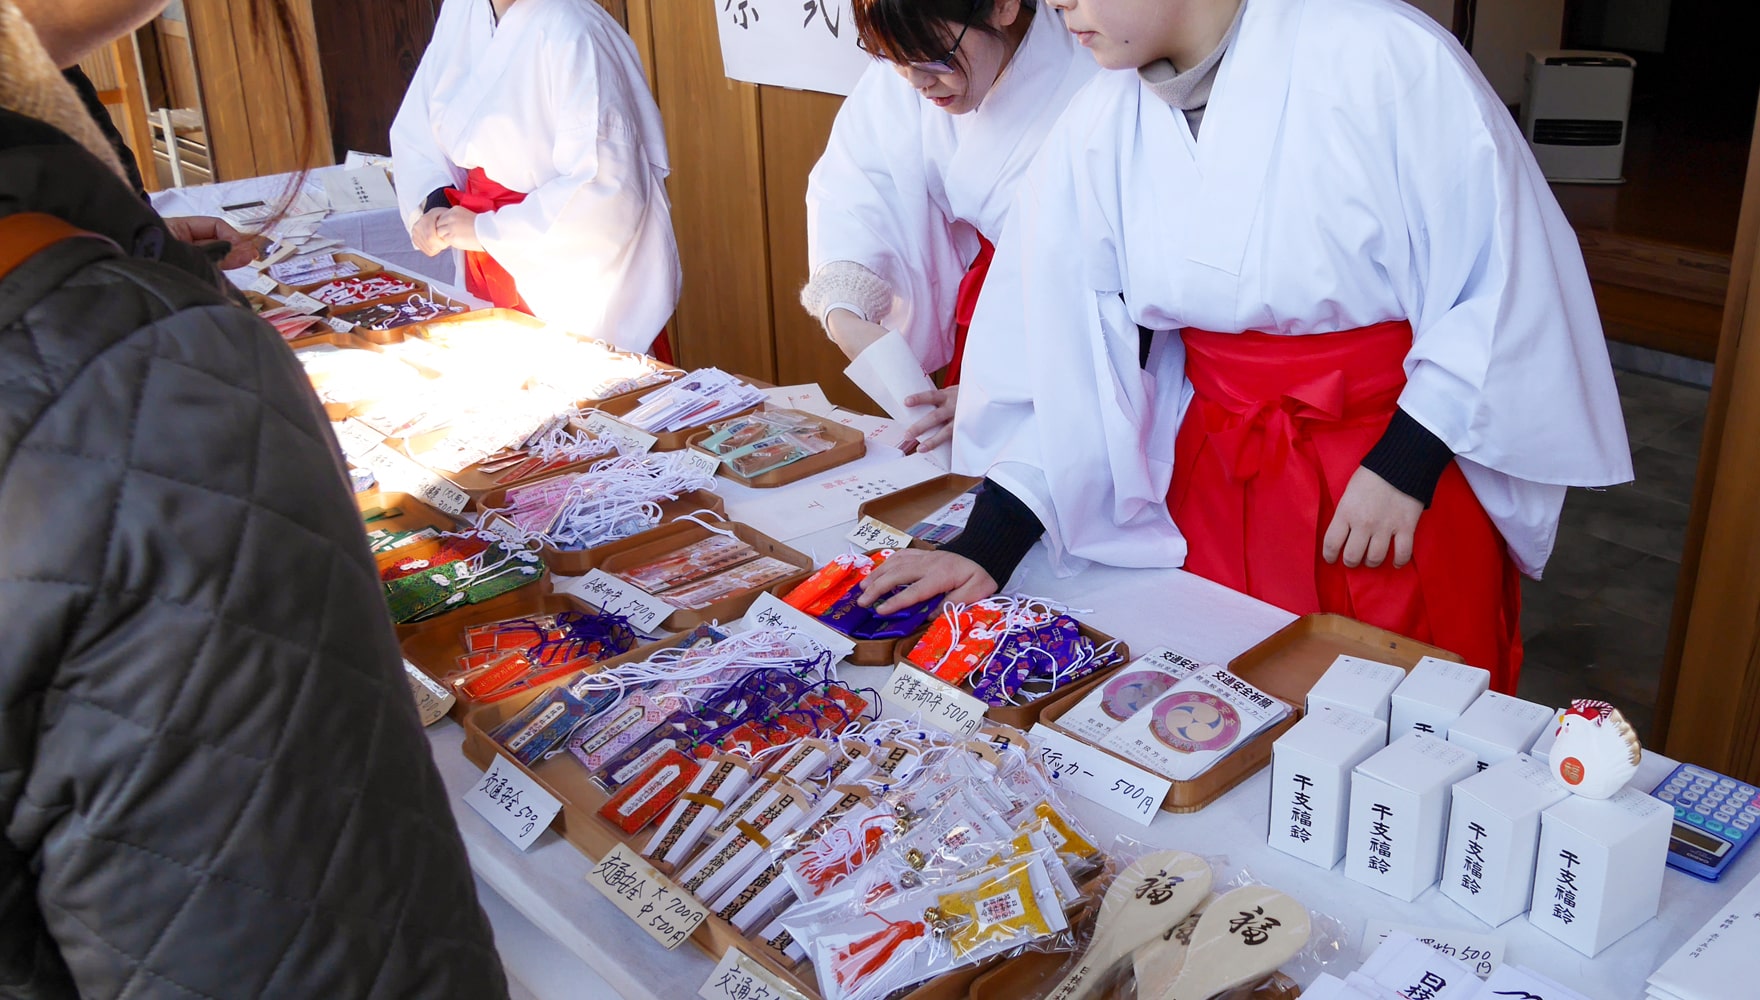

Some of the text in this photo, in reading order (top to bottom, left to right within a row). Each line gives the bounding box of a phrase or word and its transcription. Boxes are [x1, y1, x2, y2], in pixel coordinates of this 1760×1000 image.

[624, 600, 656, 624] 500円
[1159, 650, 1200, 672] 交通安全
[894, 674, 942, 712] 学業御守
[942, 702, 976, 735] 500円
[1212, 670, 1275, 710] 交通安全祈願
[480, 768, 538, 821] 交通安全 500
[1042, 747, 1094, 777] ステッカー
[1111, 779, 1154, 814] 500円
[1289, 774, 1314, 844] 干支福鈴
[1367, 803, 1394, 875] 干支福鈴
[1461, 821, 1488, 895] 干支福鈴
[593, 851, 703, 932] 交通安全 大 700円
[1135, 869, 1184, 905] 福
[1552, 849, 1581, 925] 干支福鈴
[637, 902, 686, 950] 中 500円
[1229, 905, 1281, 945] 福
[1459, 947, 1491, 961] 500
